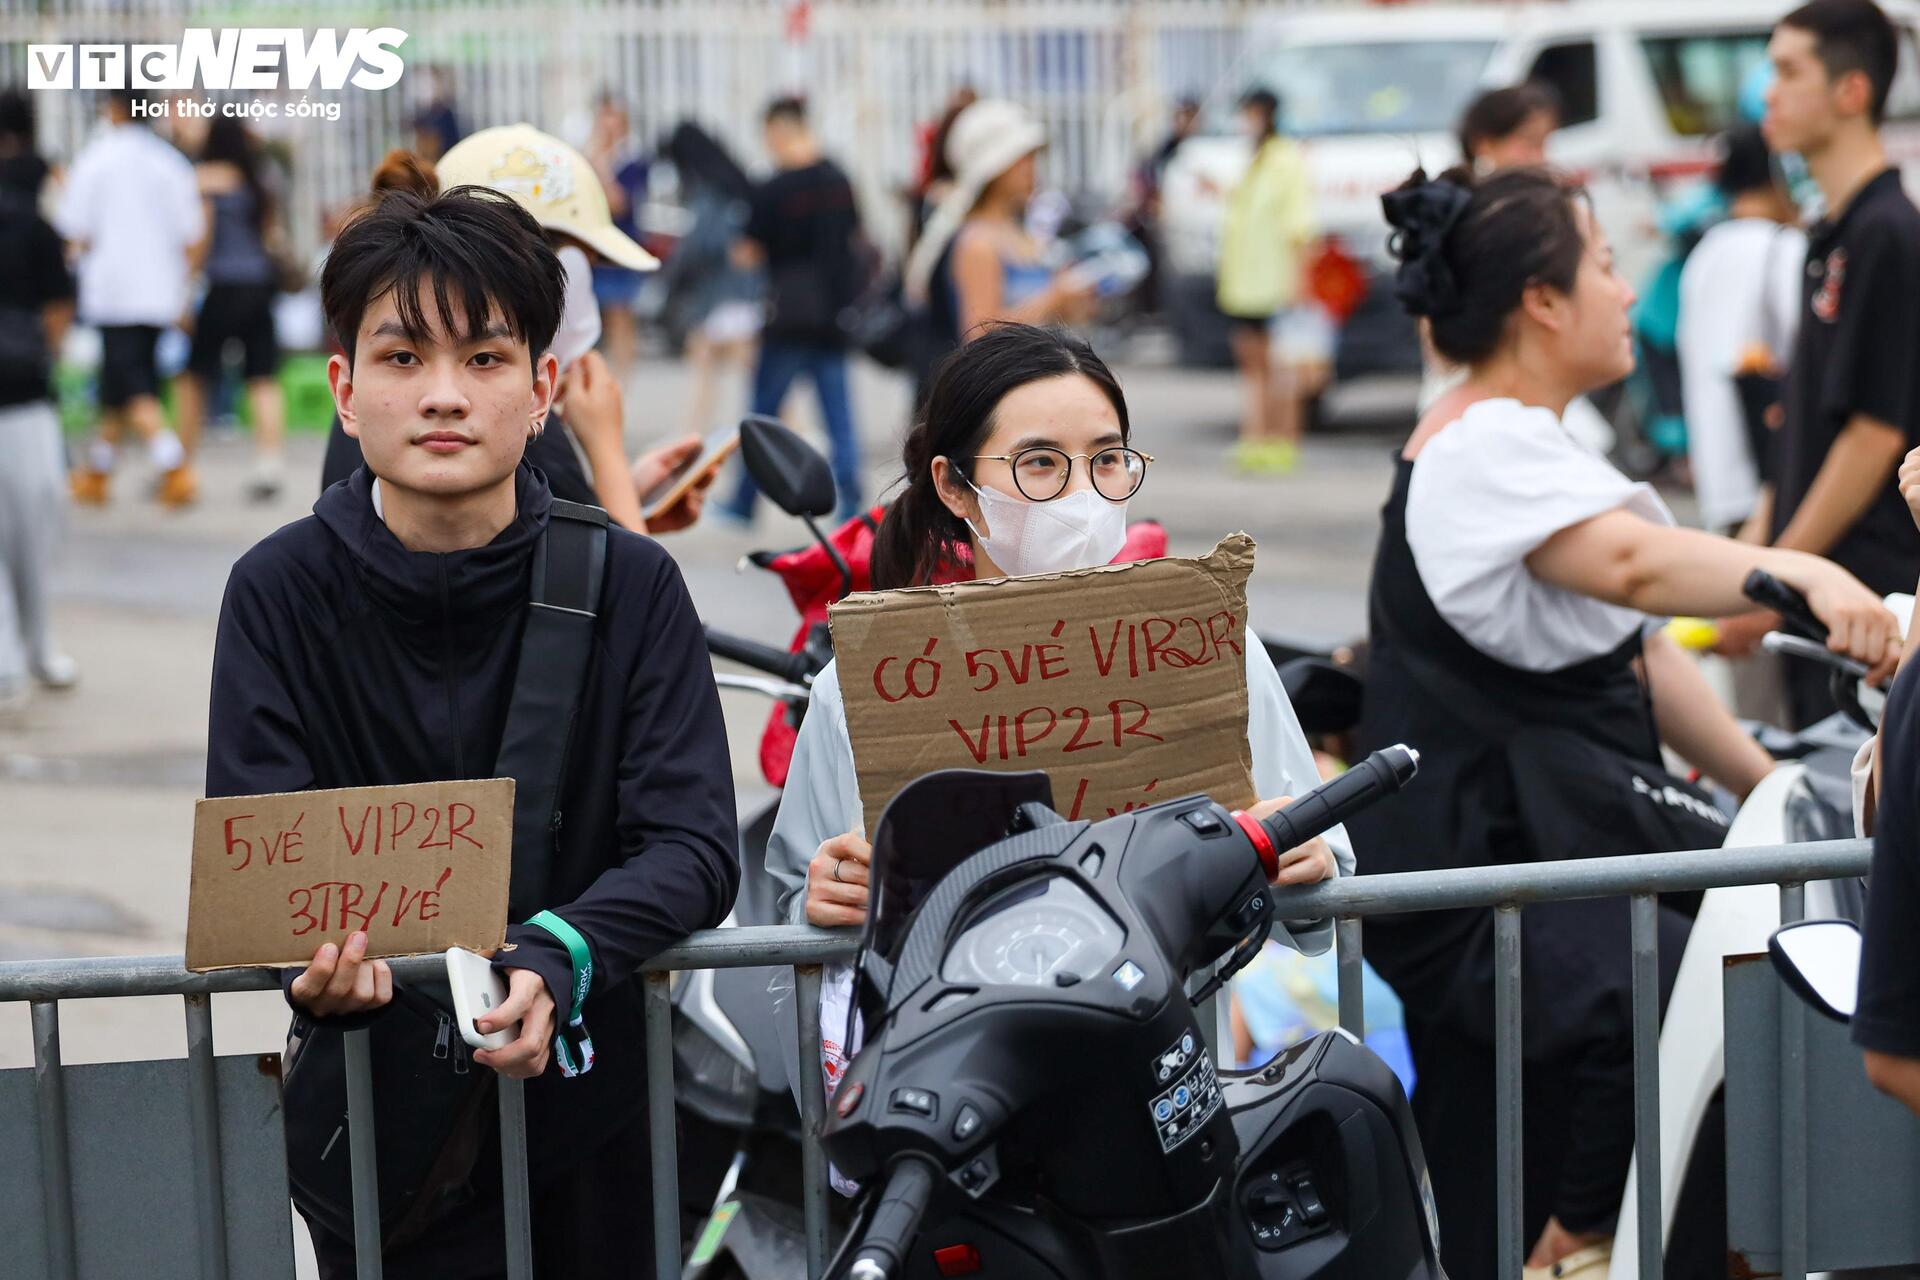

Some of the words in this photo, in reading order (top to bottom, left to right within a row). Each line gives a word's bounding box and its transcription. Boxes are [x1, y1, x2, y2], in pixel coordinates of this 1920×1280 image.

[873, 636, 941, 702] CÓ
[948, 699, 1164, 764] VIP2R
[338, 802, 484, 856] VIP2R
